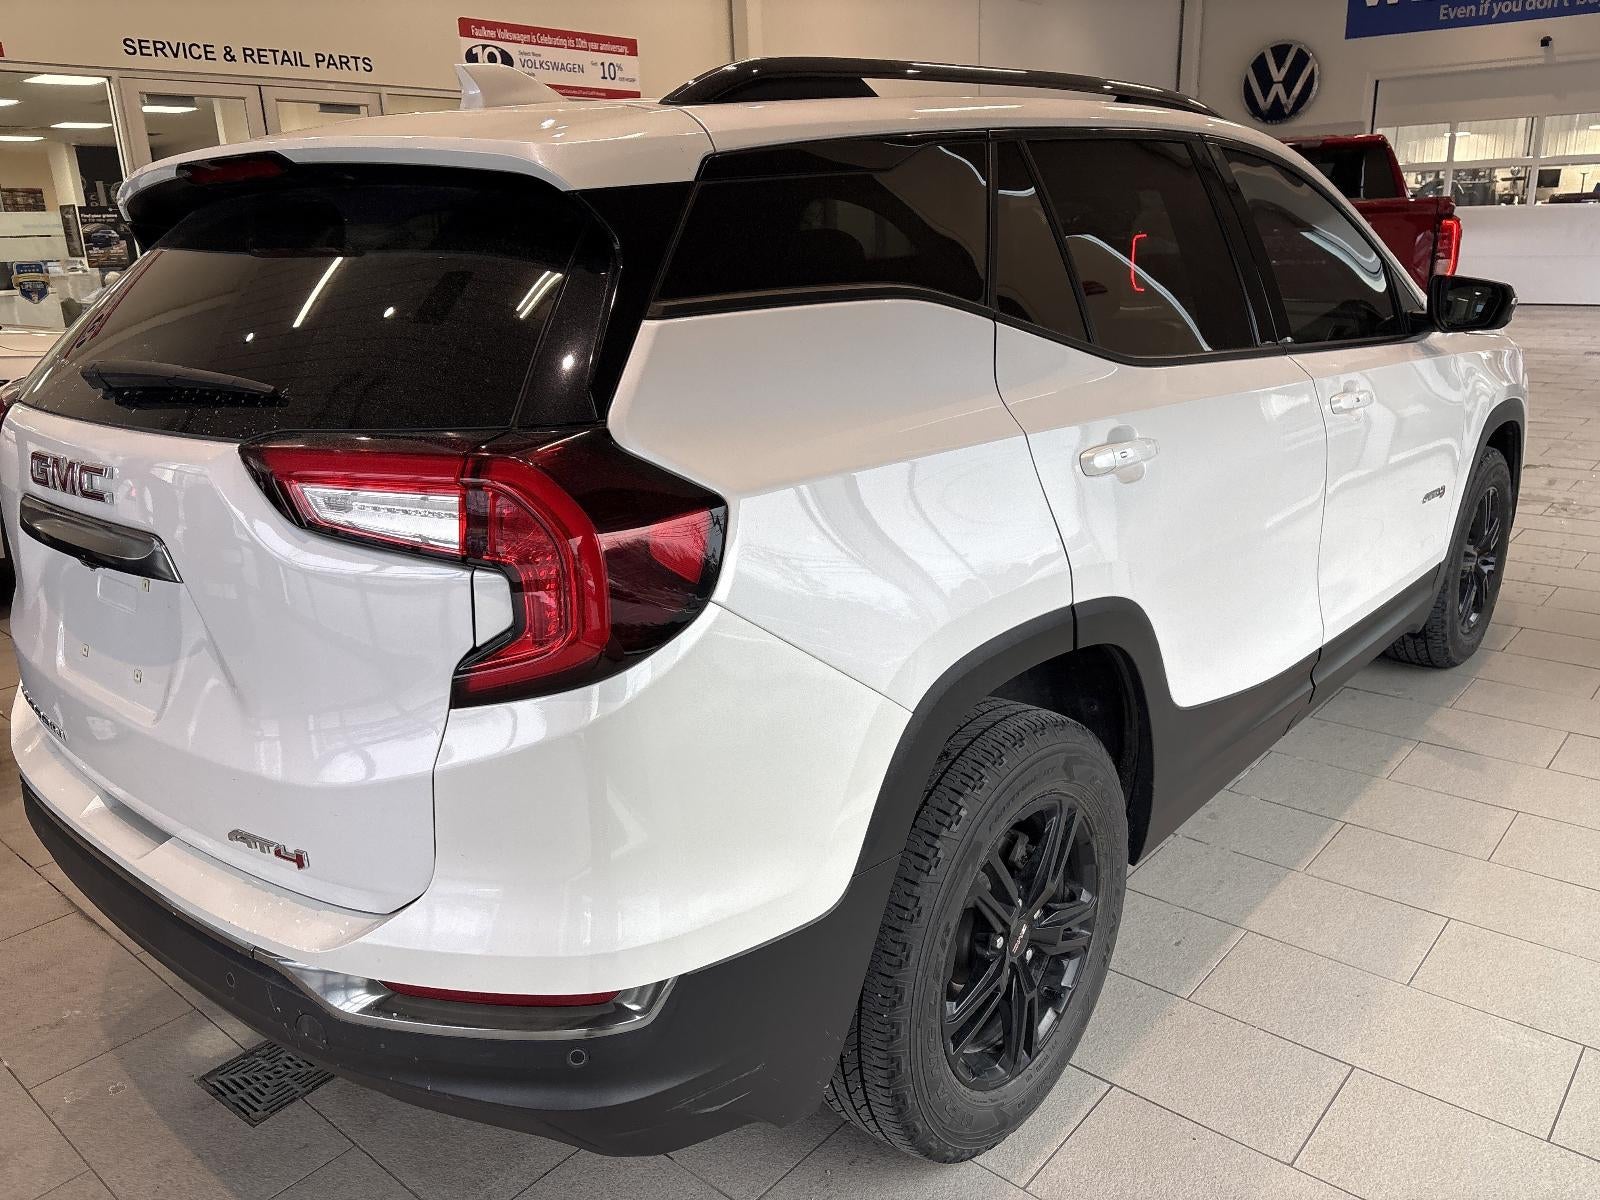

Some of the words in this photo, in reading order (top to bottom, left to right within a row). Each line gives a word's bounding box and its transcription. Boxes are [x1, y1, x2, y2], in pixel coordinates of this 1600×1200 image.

[1439, 4, 1476, 20] Even
[1479, 0, 1491, 16] if
[1491, 0, 1522, 19] you
[496, 28, 531, 44] Volkswagen
[122, 37, 217, 61] SERVICE
[223, 45, 237, 63] &
[242, 46, 311, 68] RETAIL
[314, 52, 373, 73] PARTS
[519, 58, 585, 74] VOLKSWAGEN
[31, 452, 115, 504] GMC
[227, 829, 310, 871] AT4
